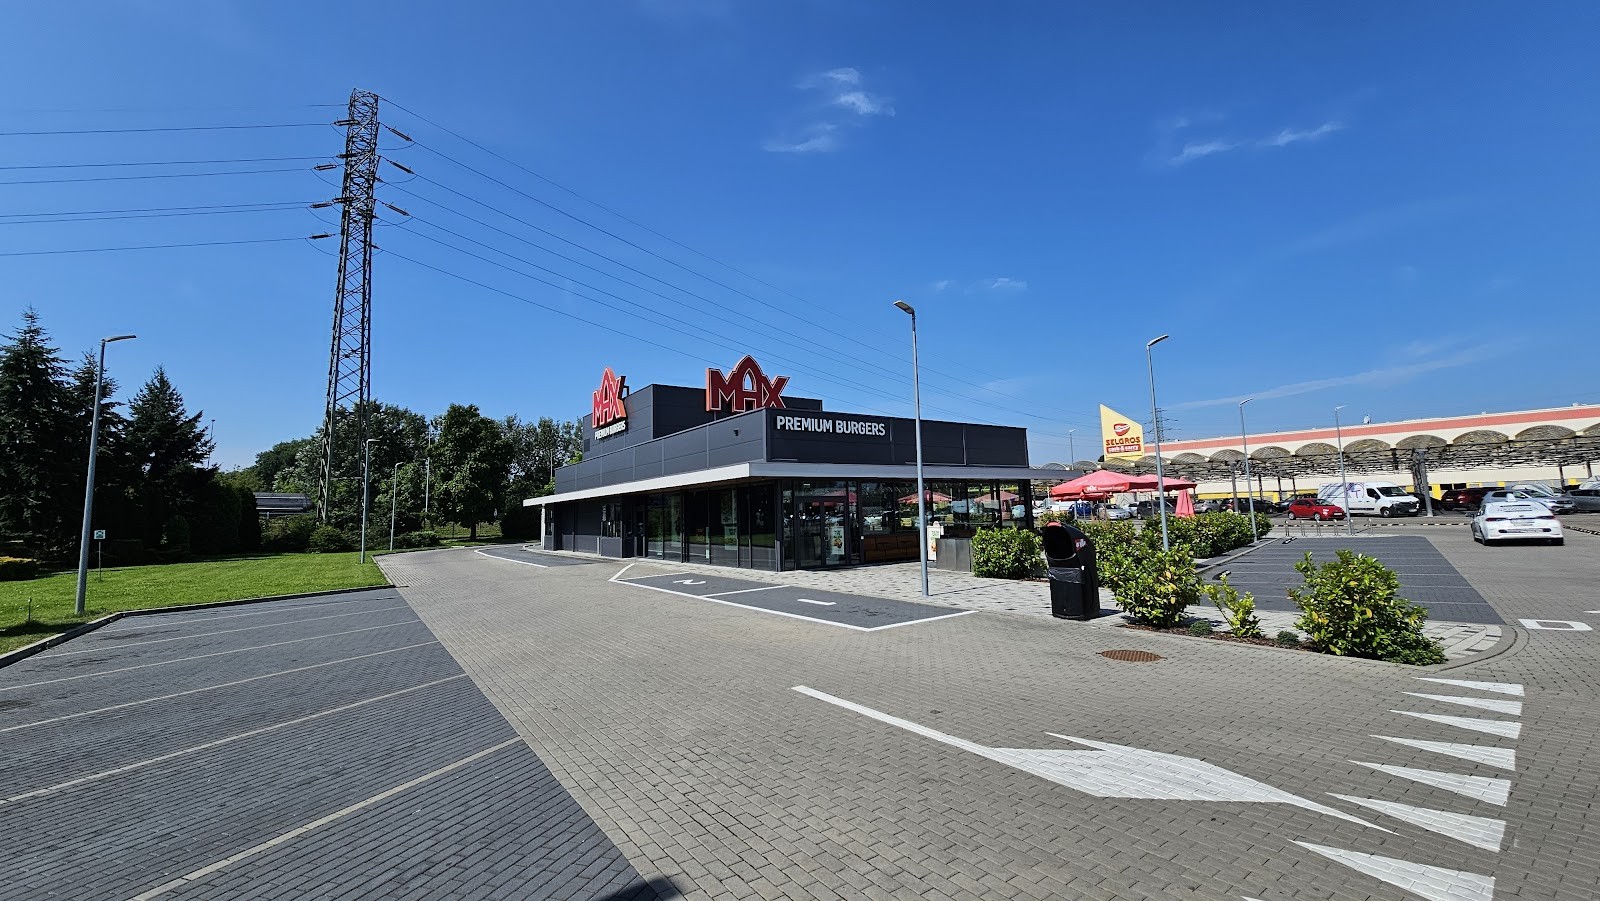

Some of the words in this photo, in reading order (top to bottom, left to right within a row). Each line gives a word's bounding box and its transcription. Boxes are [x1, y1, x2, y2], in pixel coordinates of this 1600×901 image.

[592, 367, 626, 428] MAX
[706, 354, 790, 412] MAX
[776, 415, 833, 433] PREMIUM
[835, 419, 886, 436] BURGERS
[1105, 436, 1140, 446] SELGROS
